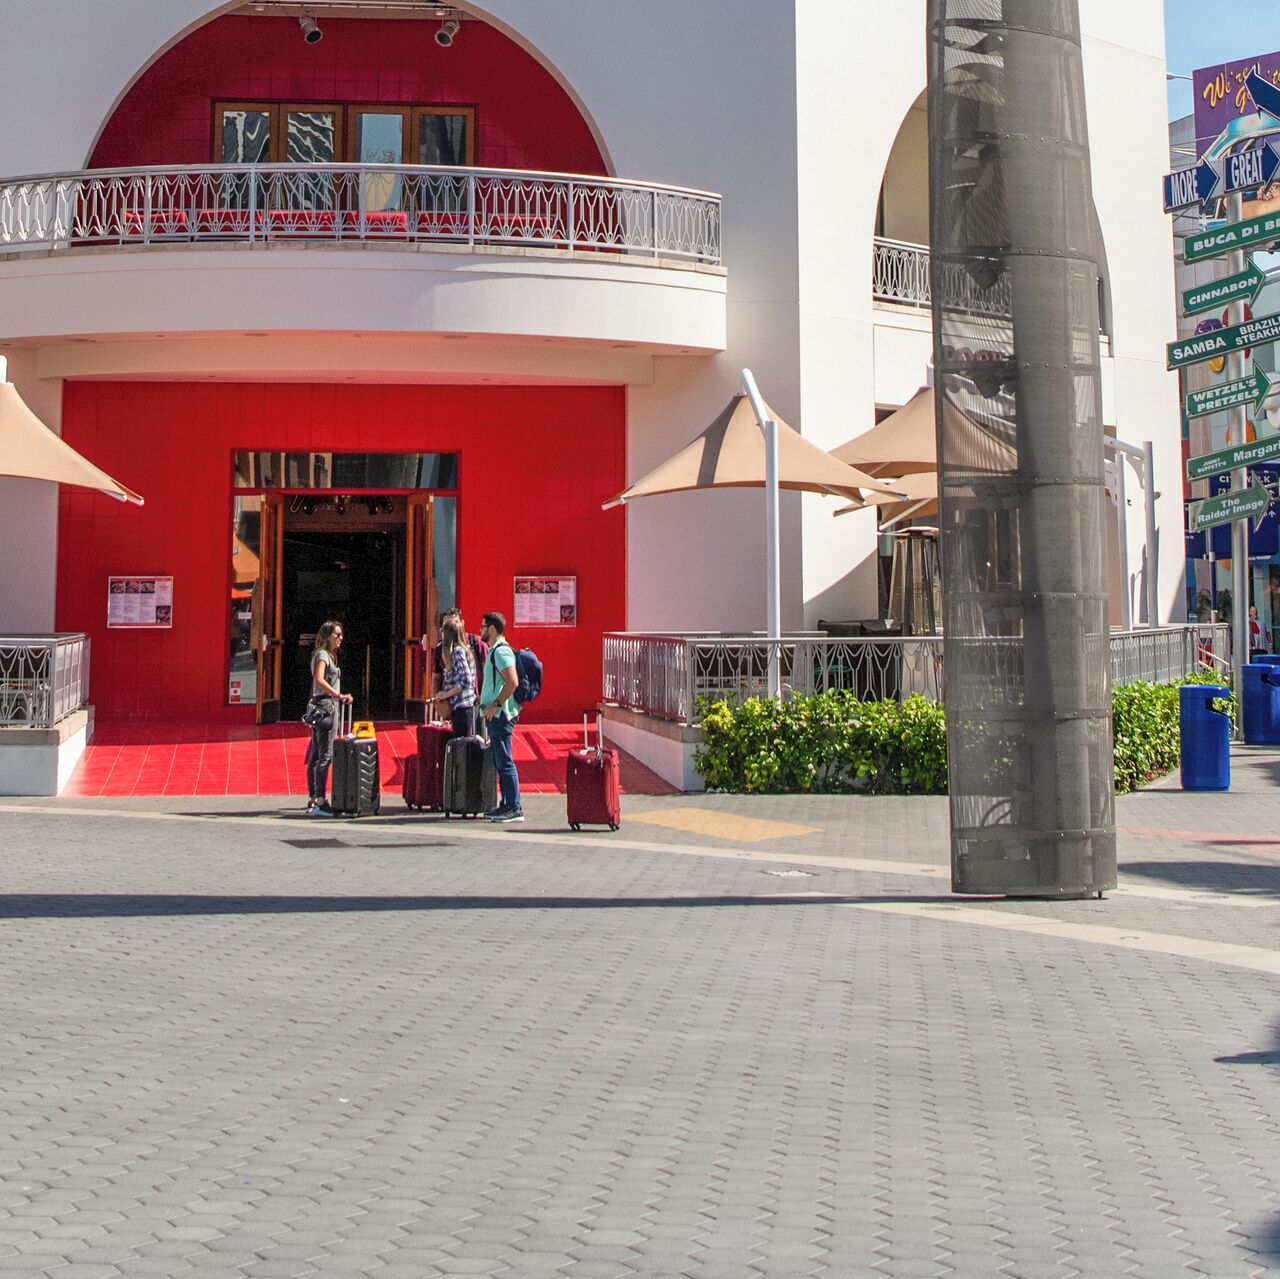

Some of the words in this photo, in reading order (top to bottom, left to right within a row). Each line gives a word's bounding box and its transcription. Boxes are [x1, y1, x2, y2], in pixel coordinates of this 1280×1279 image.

[1171, 169, 1199, 206] MORE
[1231, 149, 1264, 190] GREAT
[1193, 232, 1237, 251] BUCA
[1242, 225, 1259, 238] DI
[1189, 277, 1258, 305] CINNABON
[1174, 337, 1226, 359] SAMBA
[1193, 378, 1257, 402] WETZEL'S
[1197, 389, 1260, 412] PRETZELS
[1198, 508, 1229, 523] Raider
[1233, 499, 1264, 514] Image
[1221, 498, 1240, 508] The
